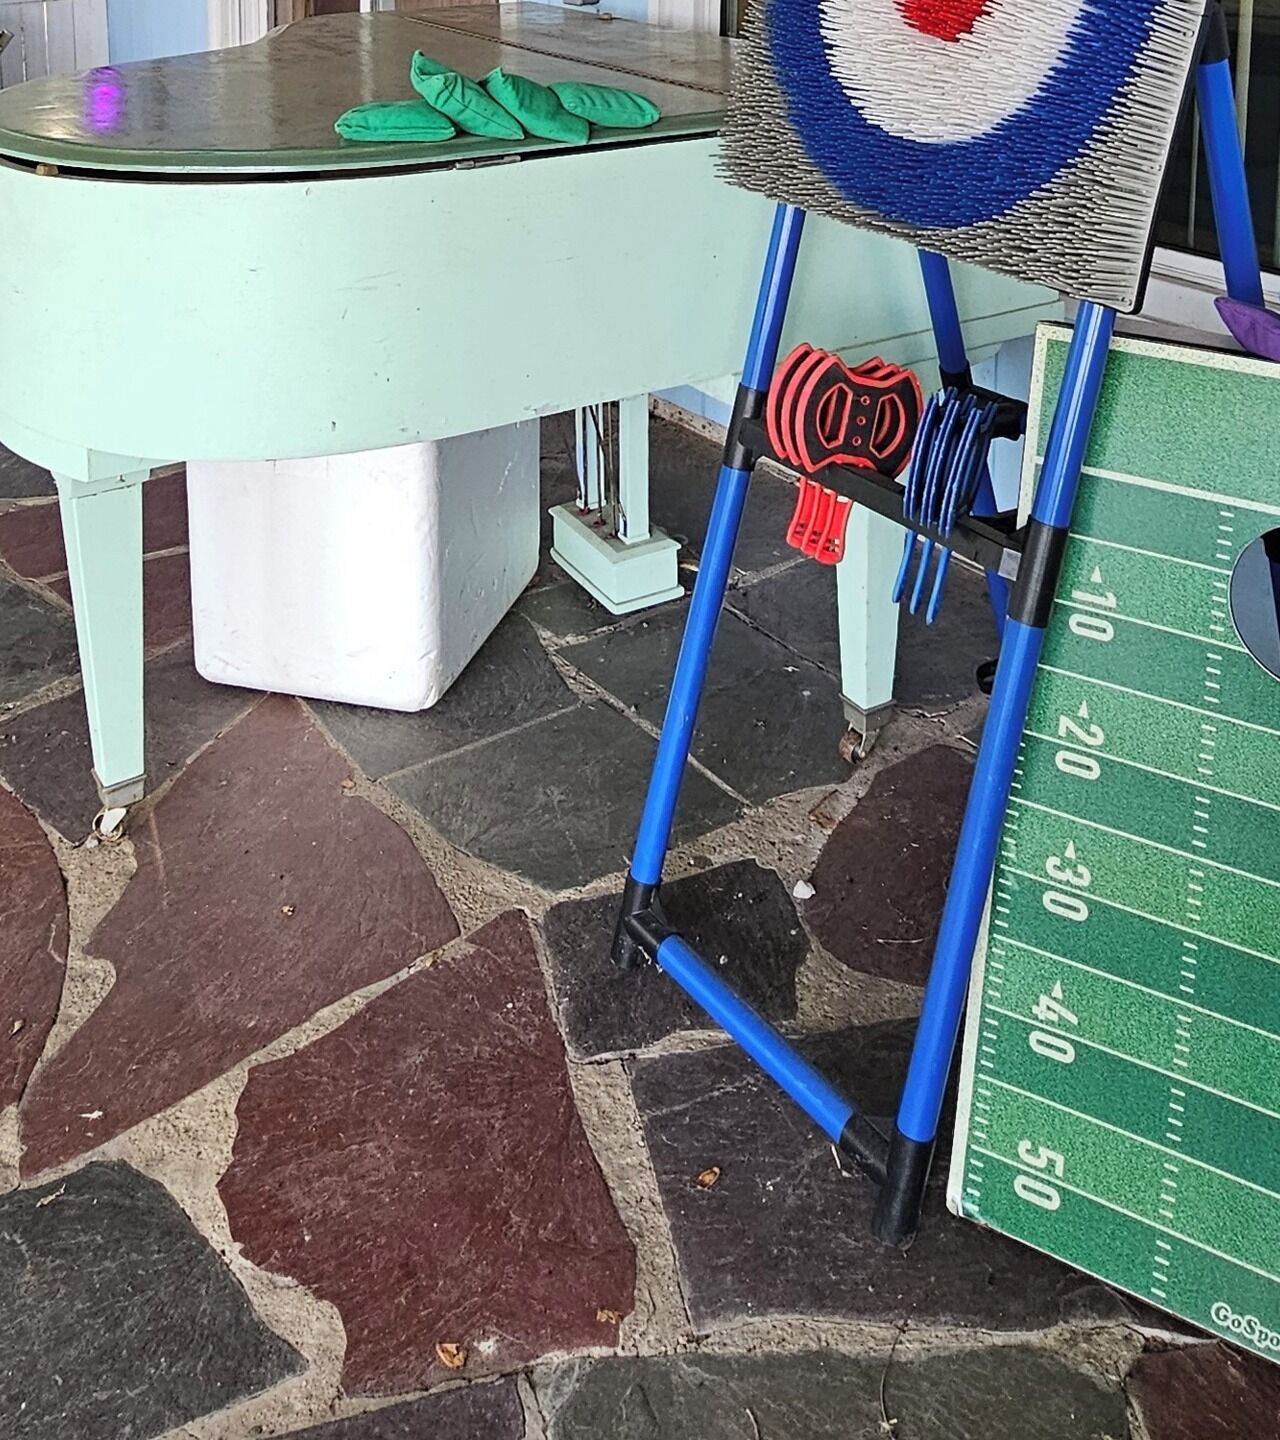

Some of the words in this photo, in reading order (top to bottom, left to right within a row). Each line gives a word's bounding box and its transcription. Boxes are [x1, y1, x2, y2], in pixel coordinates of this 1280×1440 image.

[1068, 588, 1117, 642] 10
[1055, 714, 1105, 781] 20
[1042, 855, 1091, 922] 30
[1029, 993, 1079, 1064] 40
[1013, 1139, 1065, 1211] 50
